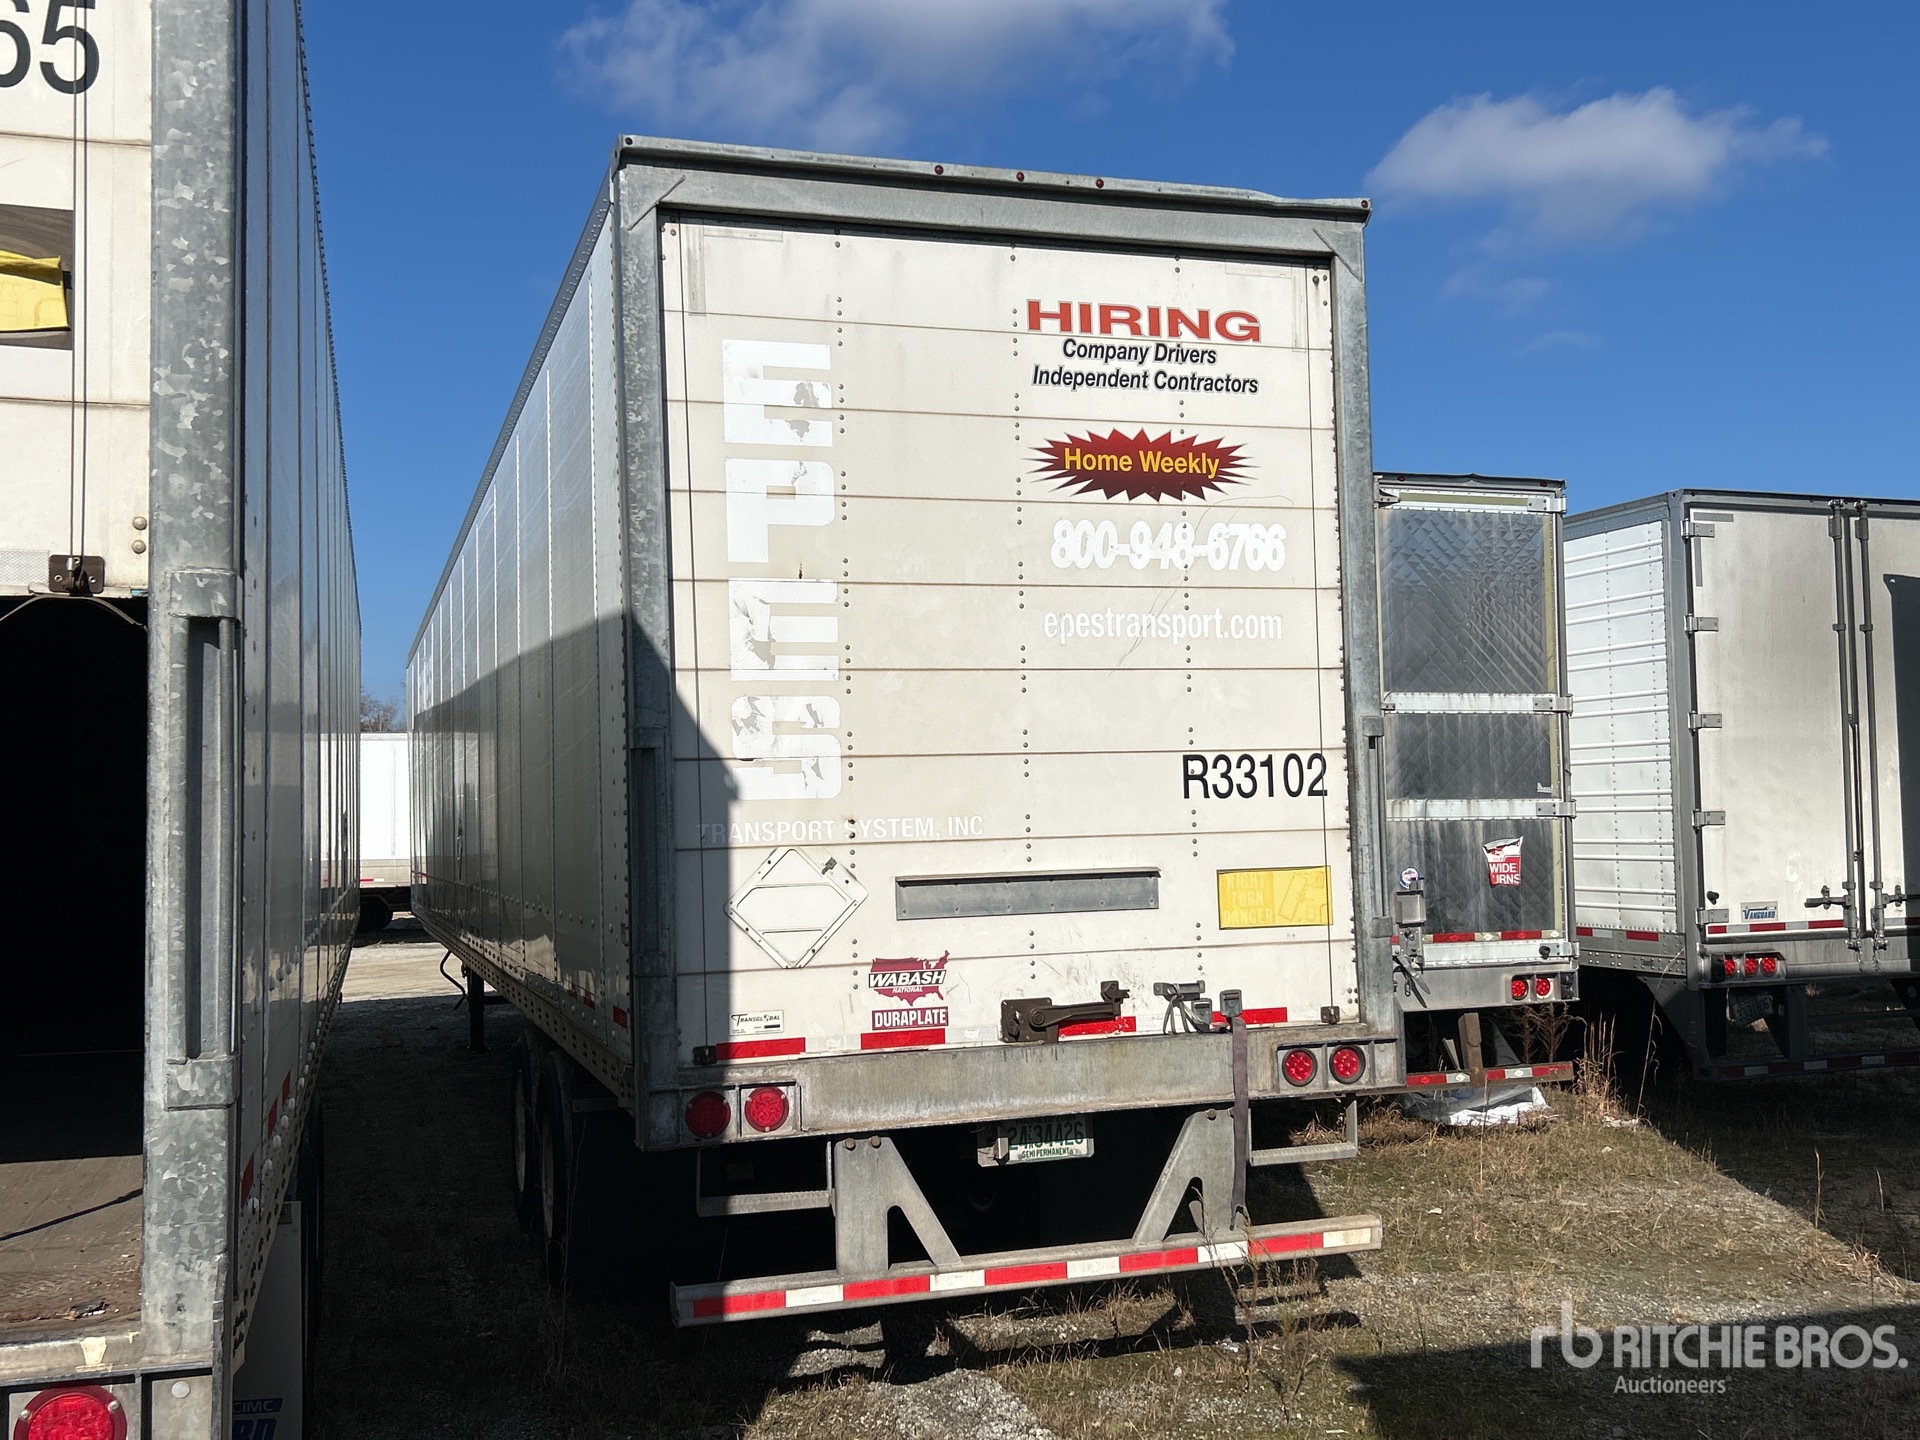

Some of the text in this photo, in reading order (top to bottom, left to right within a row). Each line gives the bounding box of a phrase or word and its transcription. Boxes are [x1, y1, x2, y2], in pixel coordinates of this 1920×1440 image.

[1026, 299, 1262, 343] HIRING
[1062, 338, 1217, 365] Company Drivers
[1032, 364, 1259, 394] Independent Contractors
[1064, 448, 1220, 479] Home Weekly
[1050, 519, 1287, 572] 800-948-6766
[1043, 607, 1282, 645] epestransport.com
[1182, 753, 1328, 799] R33102
[696, 820, 836, 844] TRANSPORT
[947, 815, 984, 836] INC
[1489, 862, 1517, 873] WIDE
[869, 970, 946, 987] WABASH
[892, 986, 923, 994] NATIONAL
[874, 1008, 947, 1028] DURAPLATE
